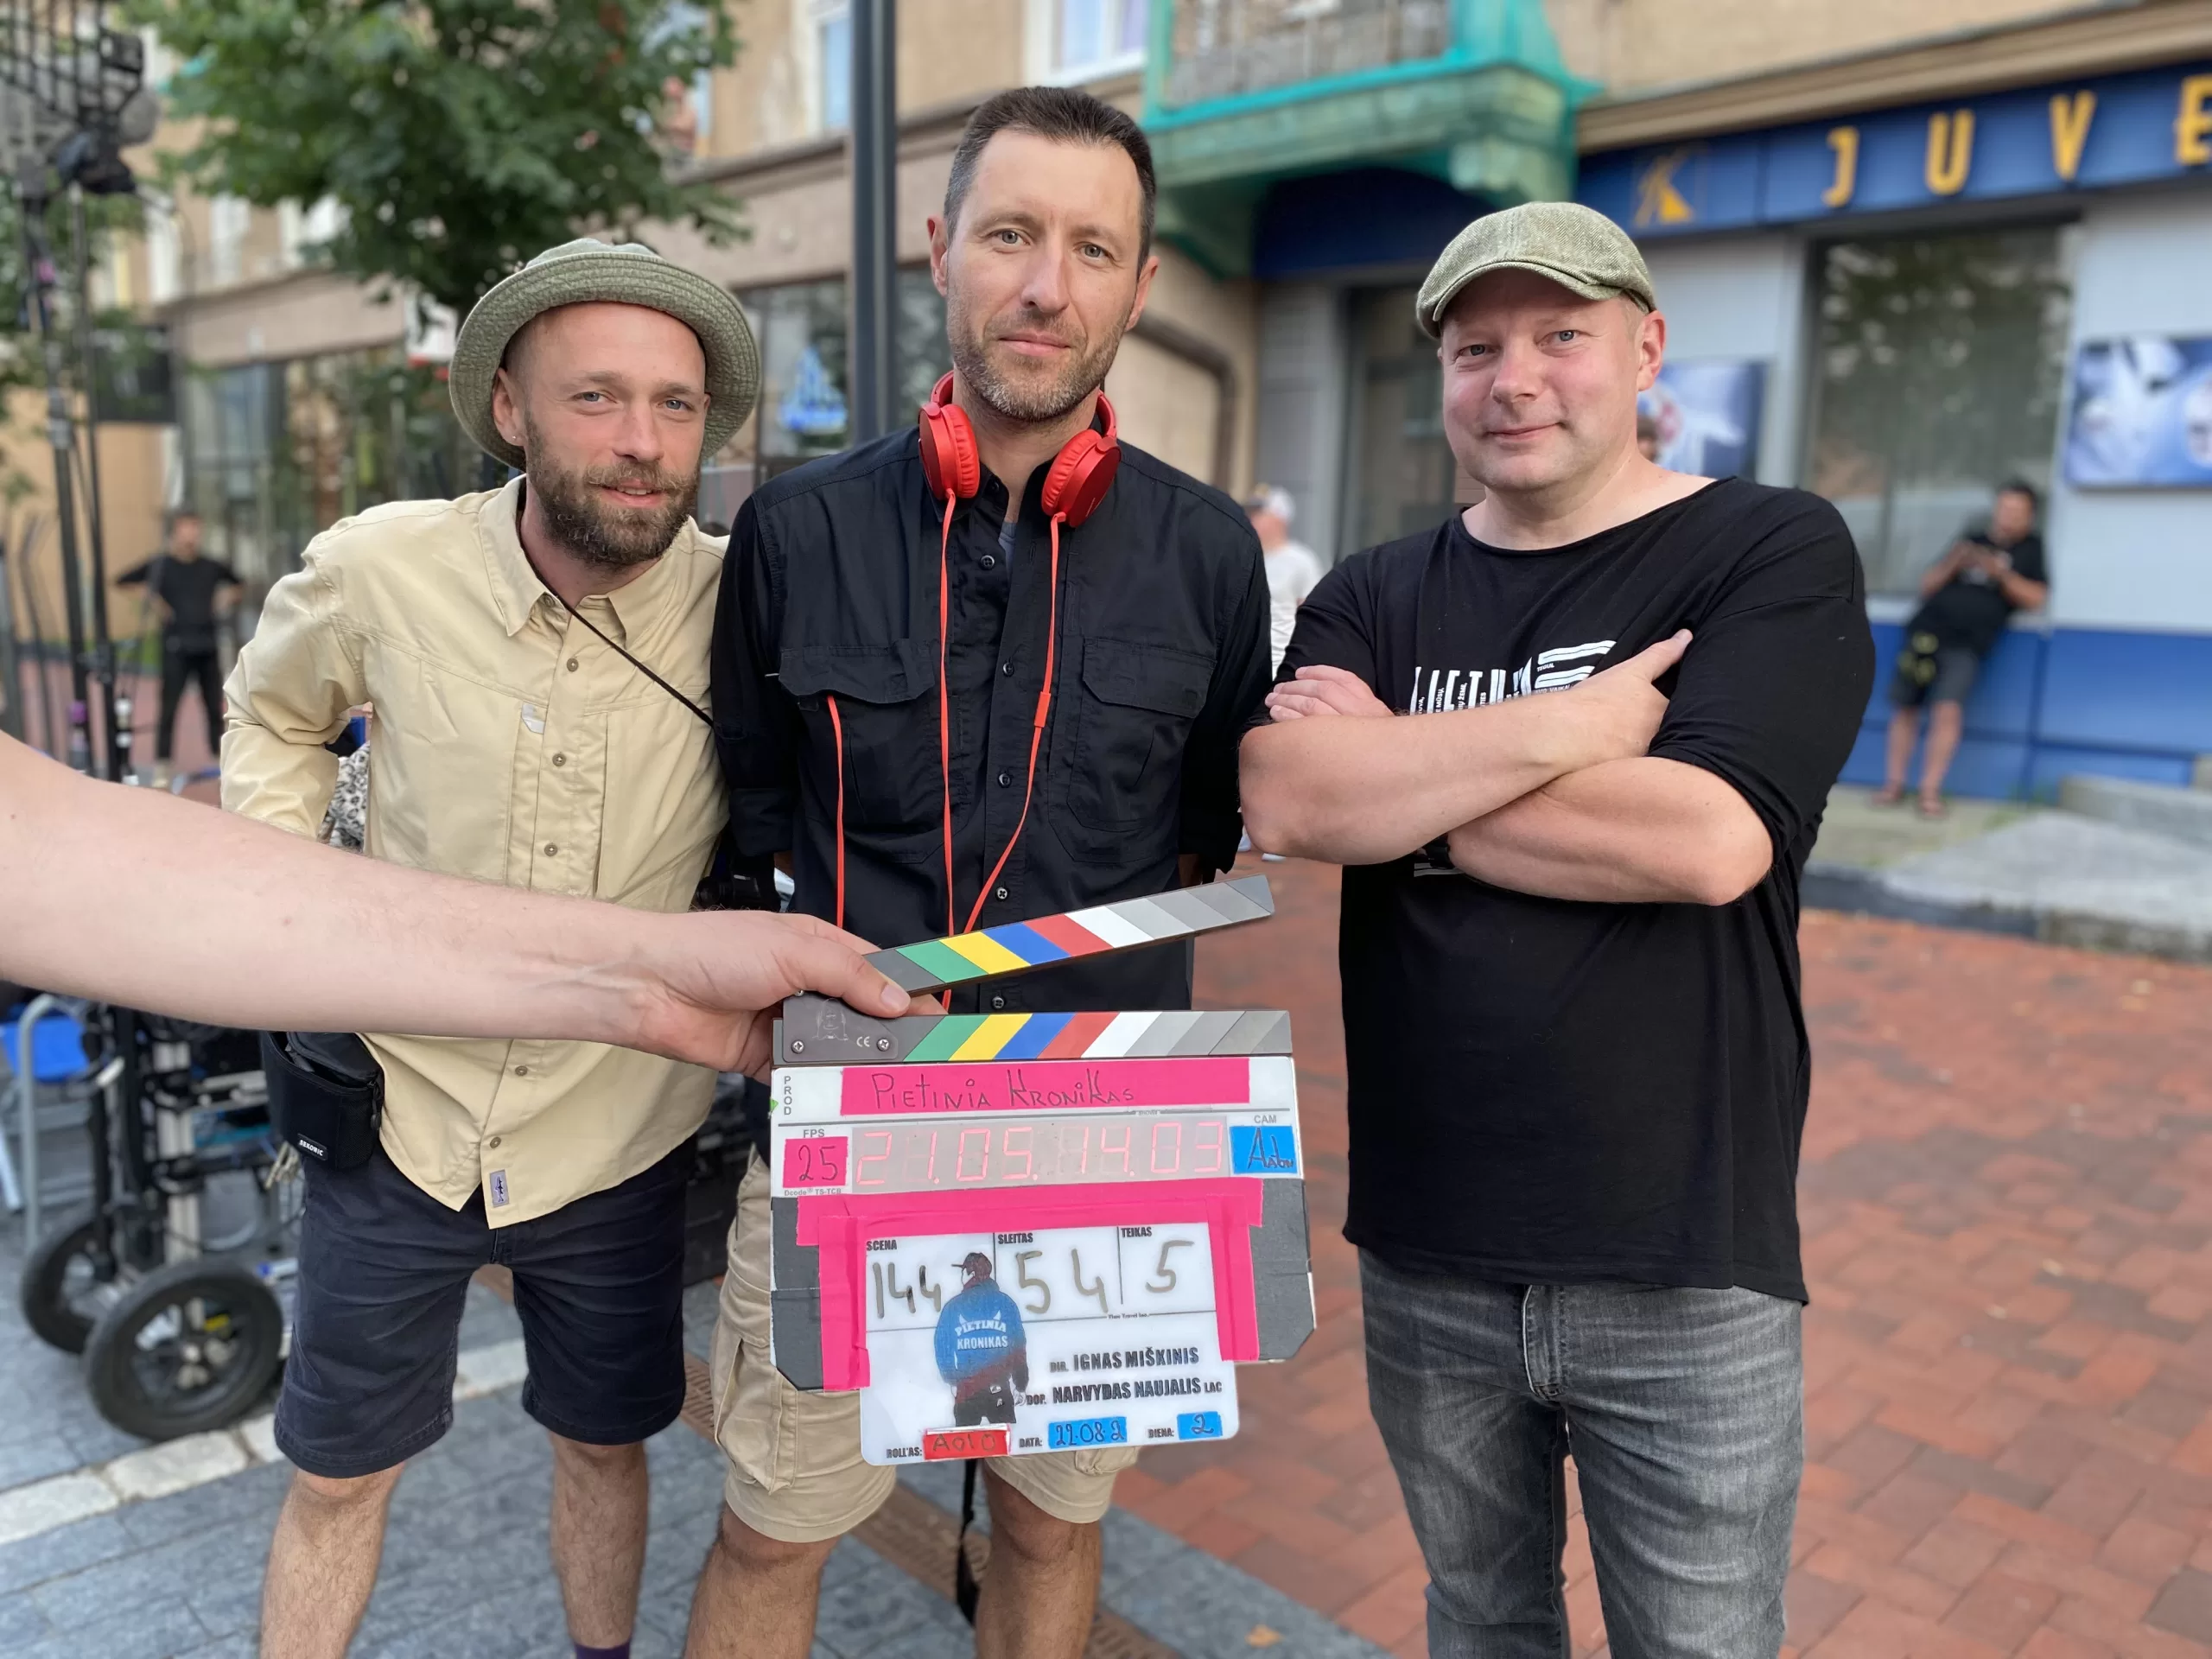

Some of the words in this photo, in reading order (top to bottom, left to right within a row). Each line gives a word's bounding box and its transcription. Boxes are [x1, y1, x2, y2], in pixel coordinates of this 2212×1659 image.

[1254, 1115, 1277, 1124] CAM
[803, 1128, 825, 1139] FPS
[299, 1139, 324, 1156] SEKONIC
[798, 1144, 839, 1182] 25
[997, 1232, 1033, 1245] SLEITAS
[1121, 1226, 1153, 1238] TEIKAS
[866, 1239, 898, 1252] SCENA
[1144, 1239, 1196, 1294] 5
[872, 1262, 942, 1319] 144
[954, 1317, 1007, 1338] PIETINIA
[957, 1335, 1009, 1351] KRONIKAS
[1073, 1351, 1122, 1372] IGNAS
[1125, 1345, 1200, 1369] MIŠKINIS
[1052, 1382, 1132, 1404] NARVYDAS
[1134, 1376, 1202, 1399] NAUJALIS
[1204, 1381, 1223, 1394] LAC
[1191, 1414, 1215, 1435] 2
[1147, 1427, 1175, 1439] DIENA:
[1019, 1436, 1043, 1448] DATA:
